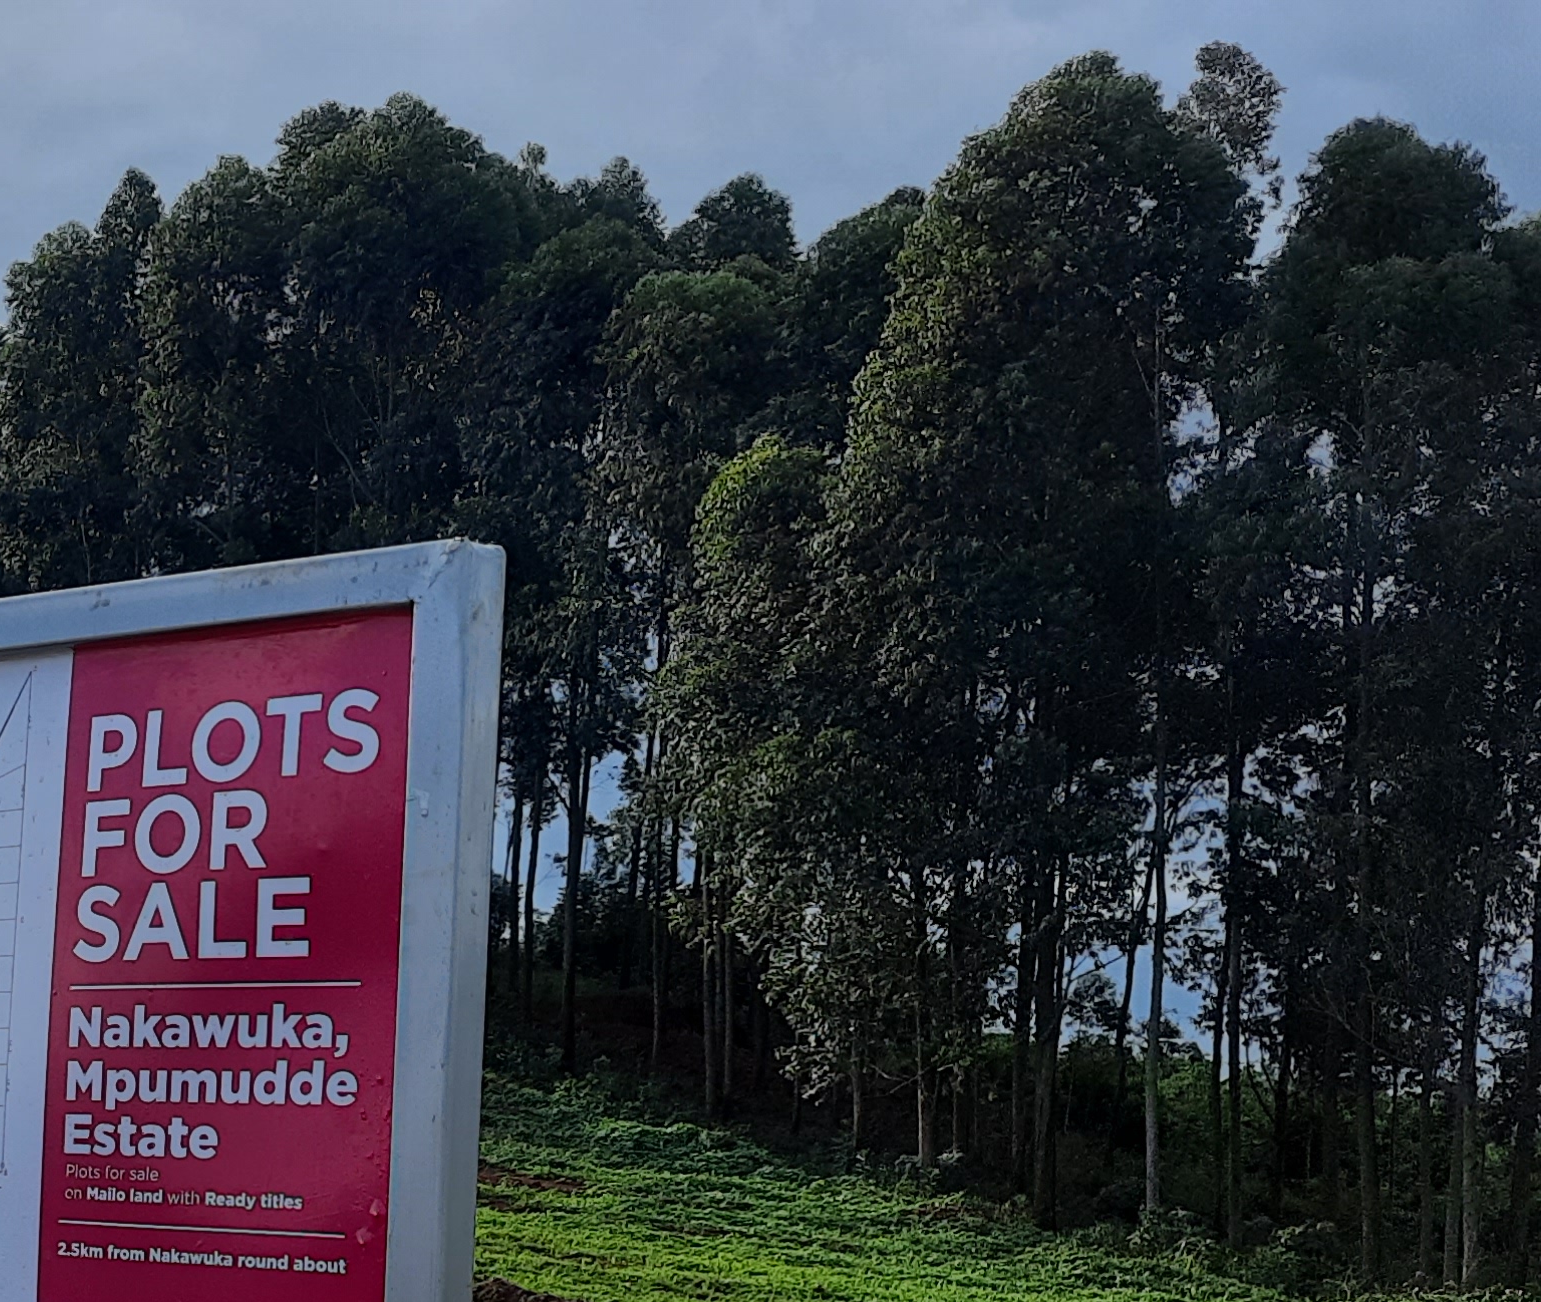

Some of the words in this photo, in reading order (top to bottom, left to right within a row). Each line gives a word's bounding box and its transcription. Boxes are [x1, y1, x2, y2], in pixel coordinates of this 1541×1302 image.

[87, 688, 380, 792] PLOTS
[81, 788, 268, 878] FOR
[72, 876, 311, 963] SALE
[68, 1003, 349, 1058] Nakawuka,
[65, 1060, 358, 1110] Mpumudde
[63, 1113, 219, 1159] Estate
[65, 1164, 101, 1180] Plots
[105, 1164, 125, 1180] for
[129, 1166, 159, 1181] sale
[64, 1188, 83, 1200] on
[86, 1187, 126, 1202] Mailo
[129, 1188, 163, 1204] land
[167, 1190, 200, 1206] with
[205, 1191, 256, 1211] Ready
[260, 1193, 303, 1210] titles
[57, 1242, 104, 1260] 2.5km
[107, 1245, 145, 1262] from
[149, 1248, 233, 1267] Nakawuka
[237, 1254, 289, 1271] round
[293, 1257, 347, 1275] about
